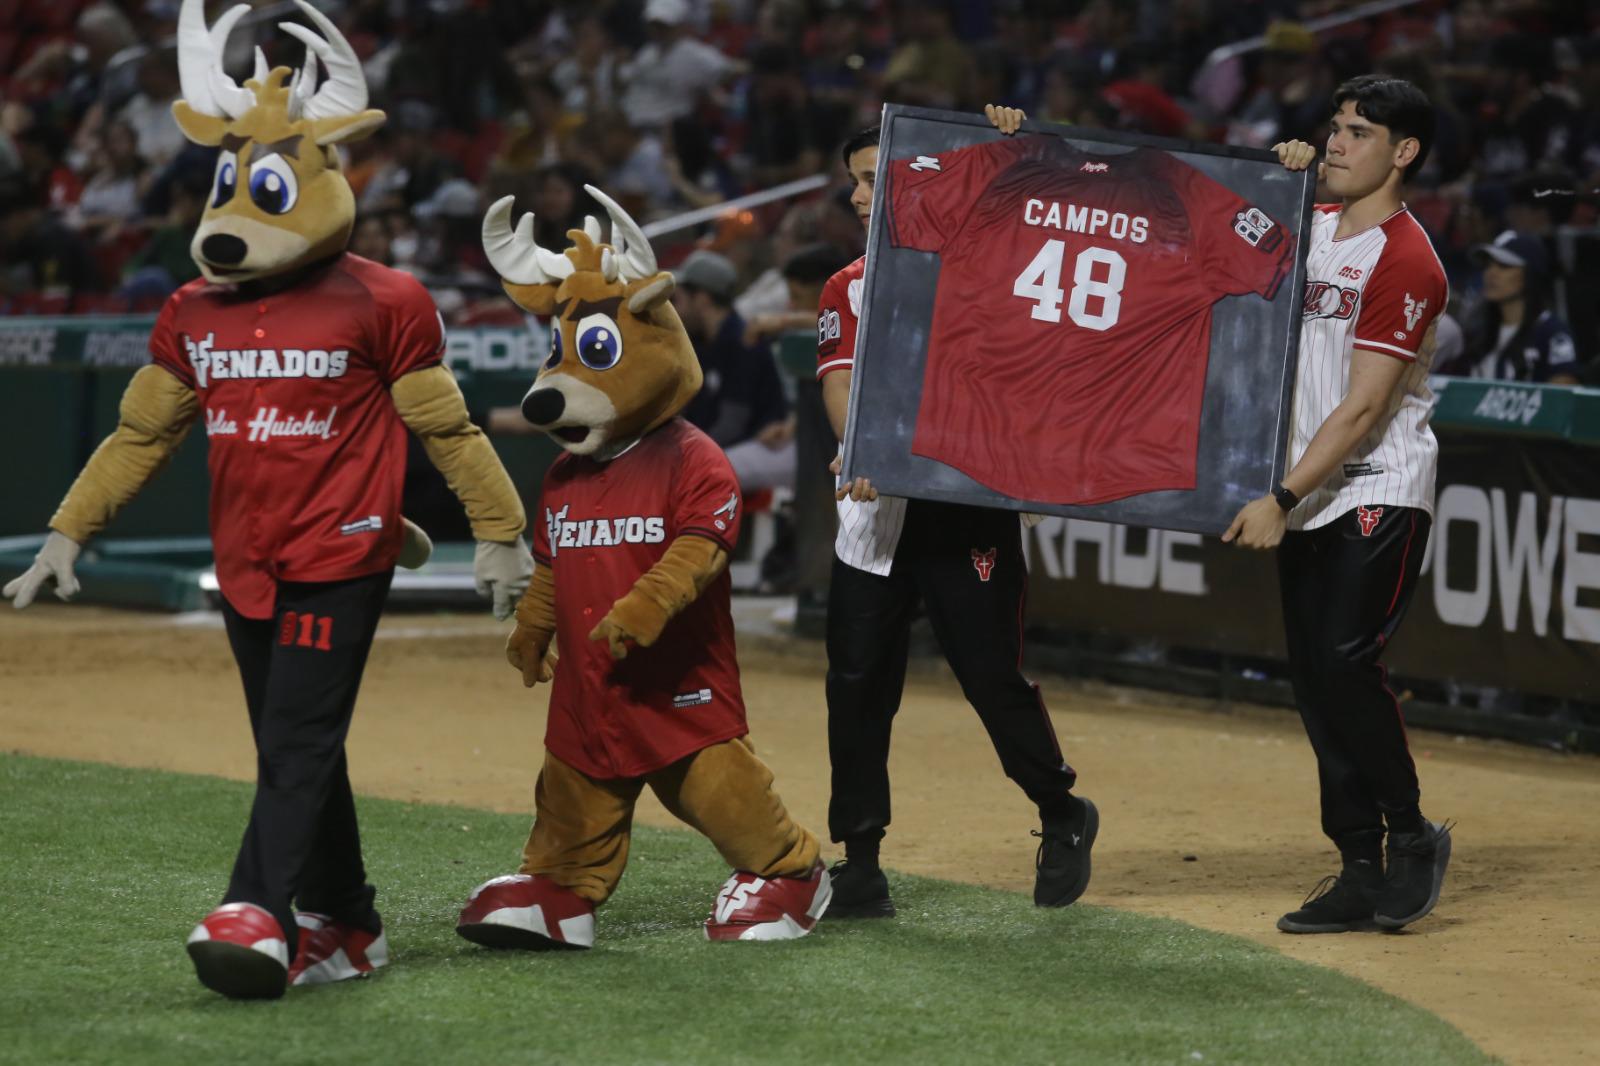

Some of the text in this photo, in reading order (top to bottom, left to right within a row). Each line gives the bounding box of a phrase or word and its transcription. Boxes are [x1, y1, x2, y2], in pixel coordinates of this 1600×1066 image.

[1024, 199, 1150, 243] CAMPOS
[1012, 239, 1128, 331] 48
[185, 332, 350, 388] VENADOS
[247, 406, 337, 442] Huichol
[546, 504, 666, 557] VENADOS
[1420, 484, 1600, 643] OWE
